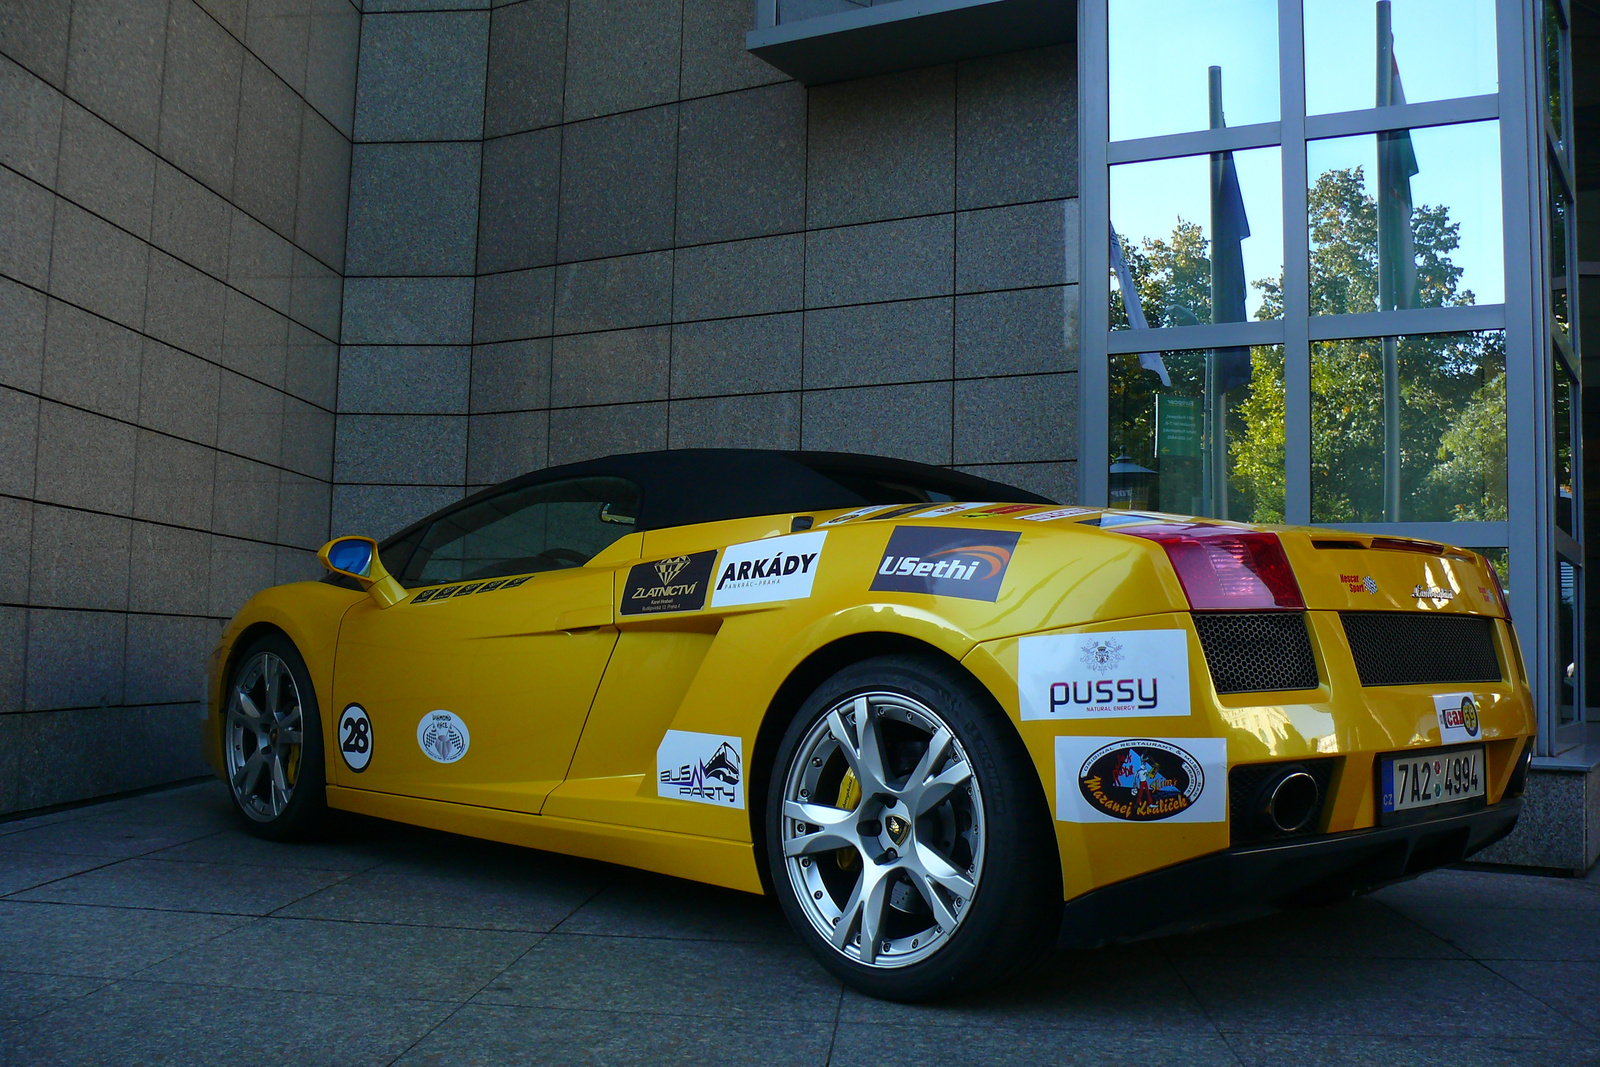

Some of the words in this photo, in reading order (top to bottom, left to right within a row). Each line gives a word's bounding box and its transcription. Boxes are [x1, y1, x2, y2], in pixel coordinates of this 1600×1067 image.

[716, 551, 818, 590] ARKÁDY
[878, 556, 980, 581] USethi
[631, 581, 698, 599] ZLATNICTVÍ
[1349, 583, 1365, 593] Sport
[1050, 677, 1158, 713] pussy
[1462, 704, 1477, 729] 69
[343, 717, 369, 754] 28
[1120, 741, 1173, 751] RESTAURANT
[1083, 747, 1115, 772] ORIGINAL
[1184, 755, 1201, 776] MUSIC
[660, 764, 691, 782] BUS
[1184, 765, 1195, 795] PRAGUE
[1398, 762, 1431, 804] 7A2
[1444, 754, 1479, 796] 4994
[679, 786, 736, 803] PARTY
[1083, 775, 1134, 818] Mazanej
[1192, 782, 1202, 798] BAR
[1383, 793, 1393, 805] CZ
